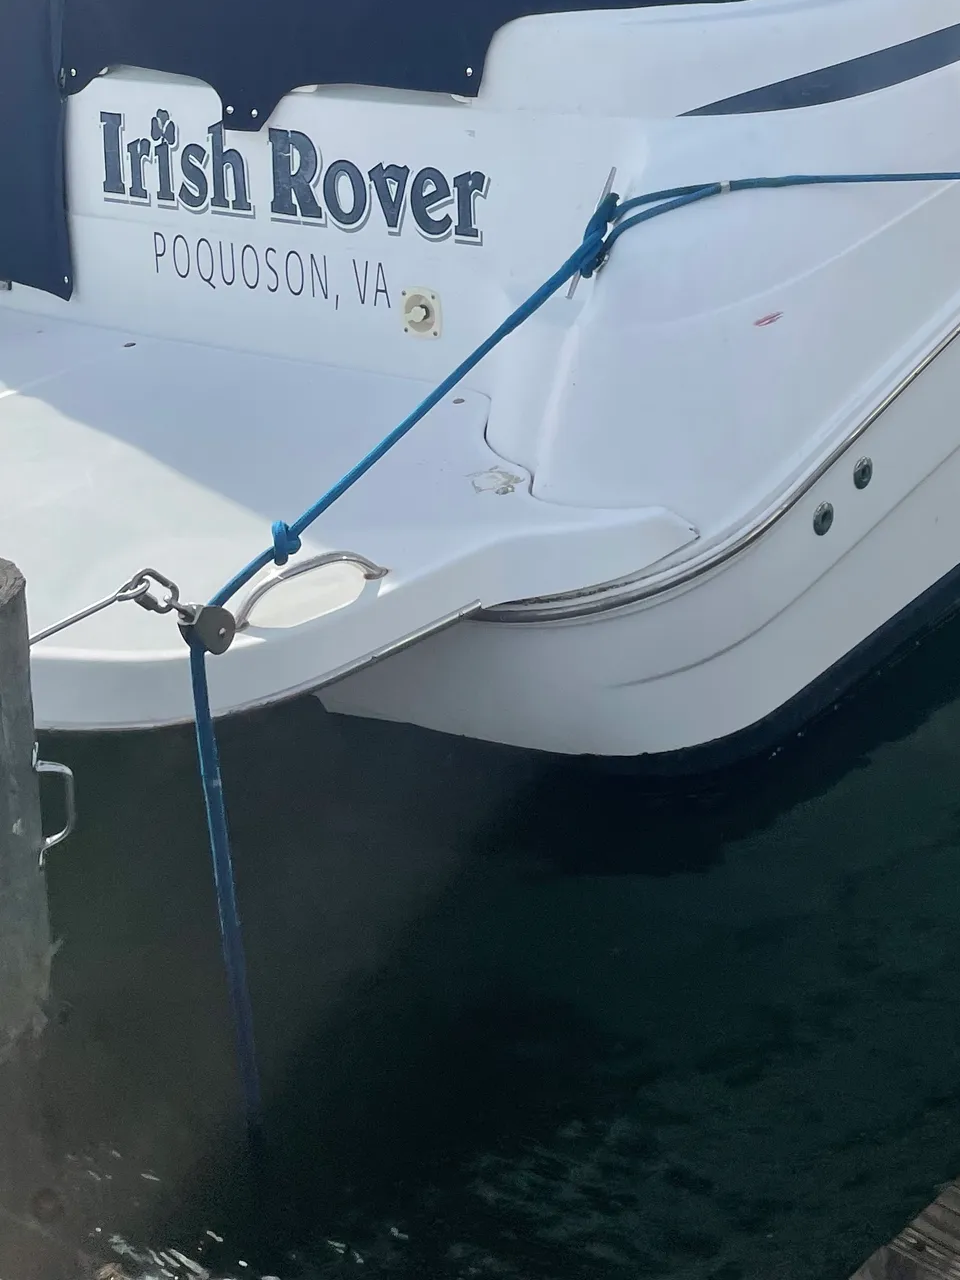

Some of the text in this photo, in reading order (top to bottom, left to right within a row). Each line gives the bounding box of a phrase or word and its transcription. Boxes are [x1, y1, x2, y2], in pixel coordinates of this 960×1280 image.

[100, 109, 490, 245] Irish Rover
[153, 231, 391, 310] POQUOSON, VA
